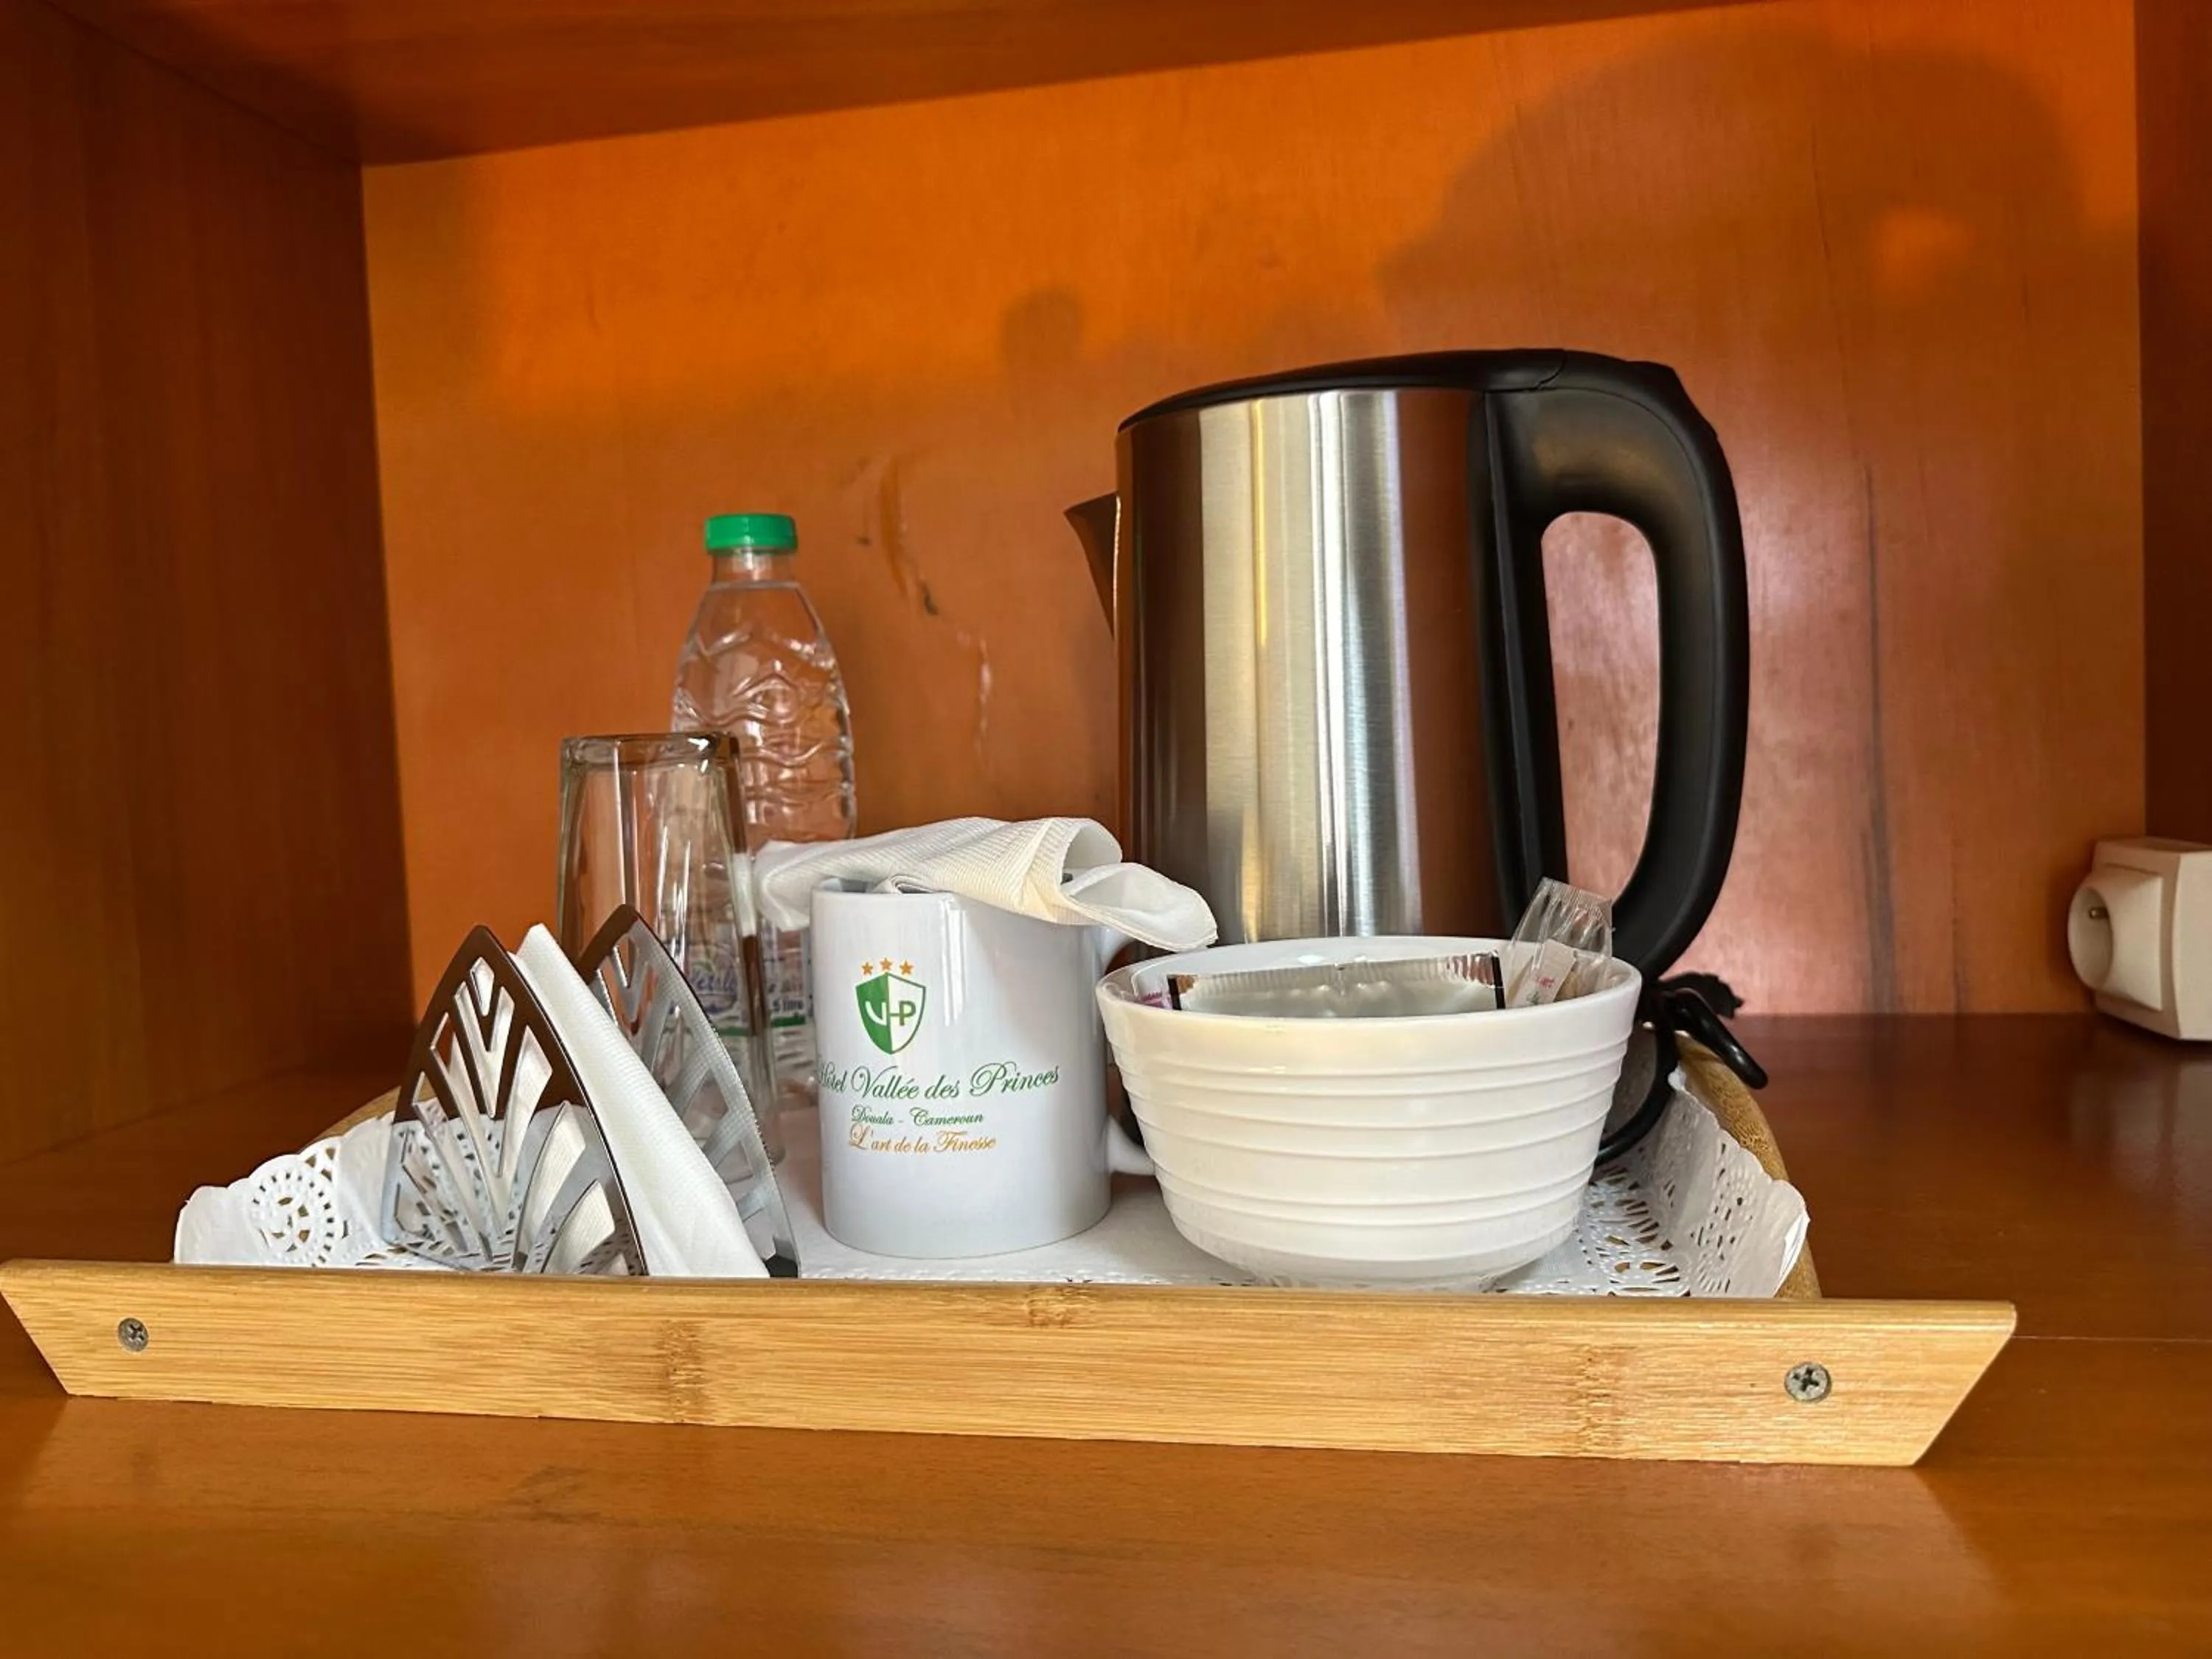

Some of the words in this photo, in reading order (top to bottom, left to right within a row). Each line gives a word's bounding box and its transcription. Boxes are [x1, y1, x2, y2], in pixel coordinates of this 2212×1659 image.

[850, 1065, 920, 1099] Vallée
[924, 1074, 961, 1099] des
[970, 1061, 1059, 1097] Princes
[851, 1105, 894, 1125] Douala
[909, 1107, 984, 1127] Cameroun
[849, 1122, 891, 1152] L'art
[894, 1136, 912, 1152] de
[914, 1136, 930, 1152] la
[933, 1130, 997, 1153] Finesse
